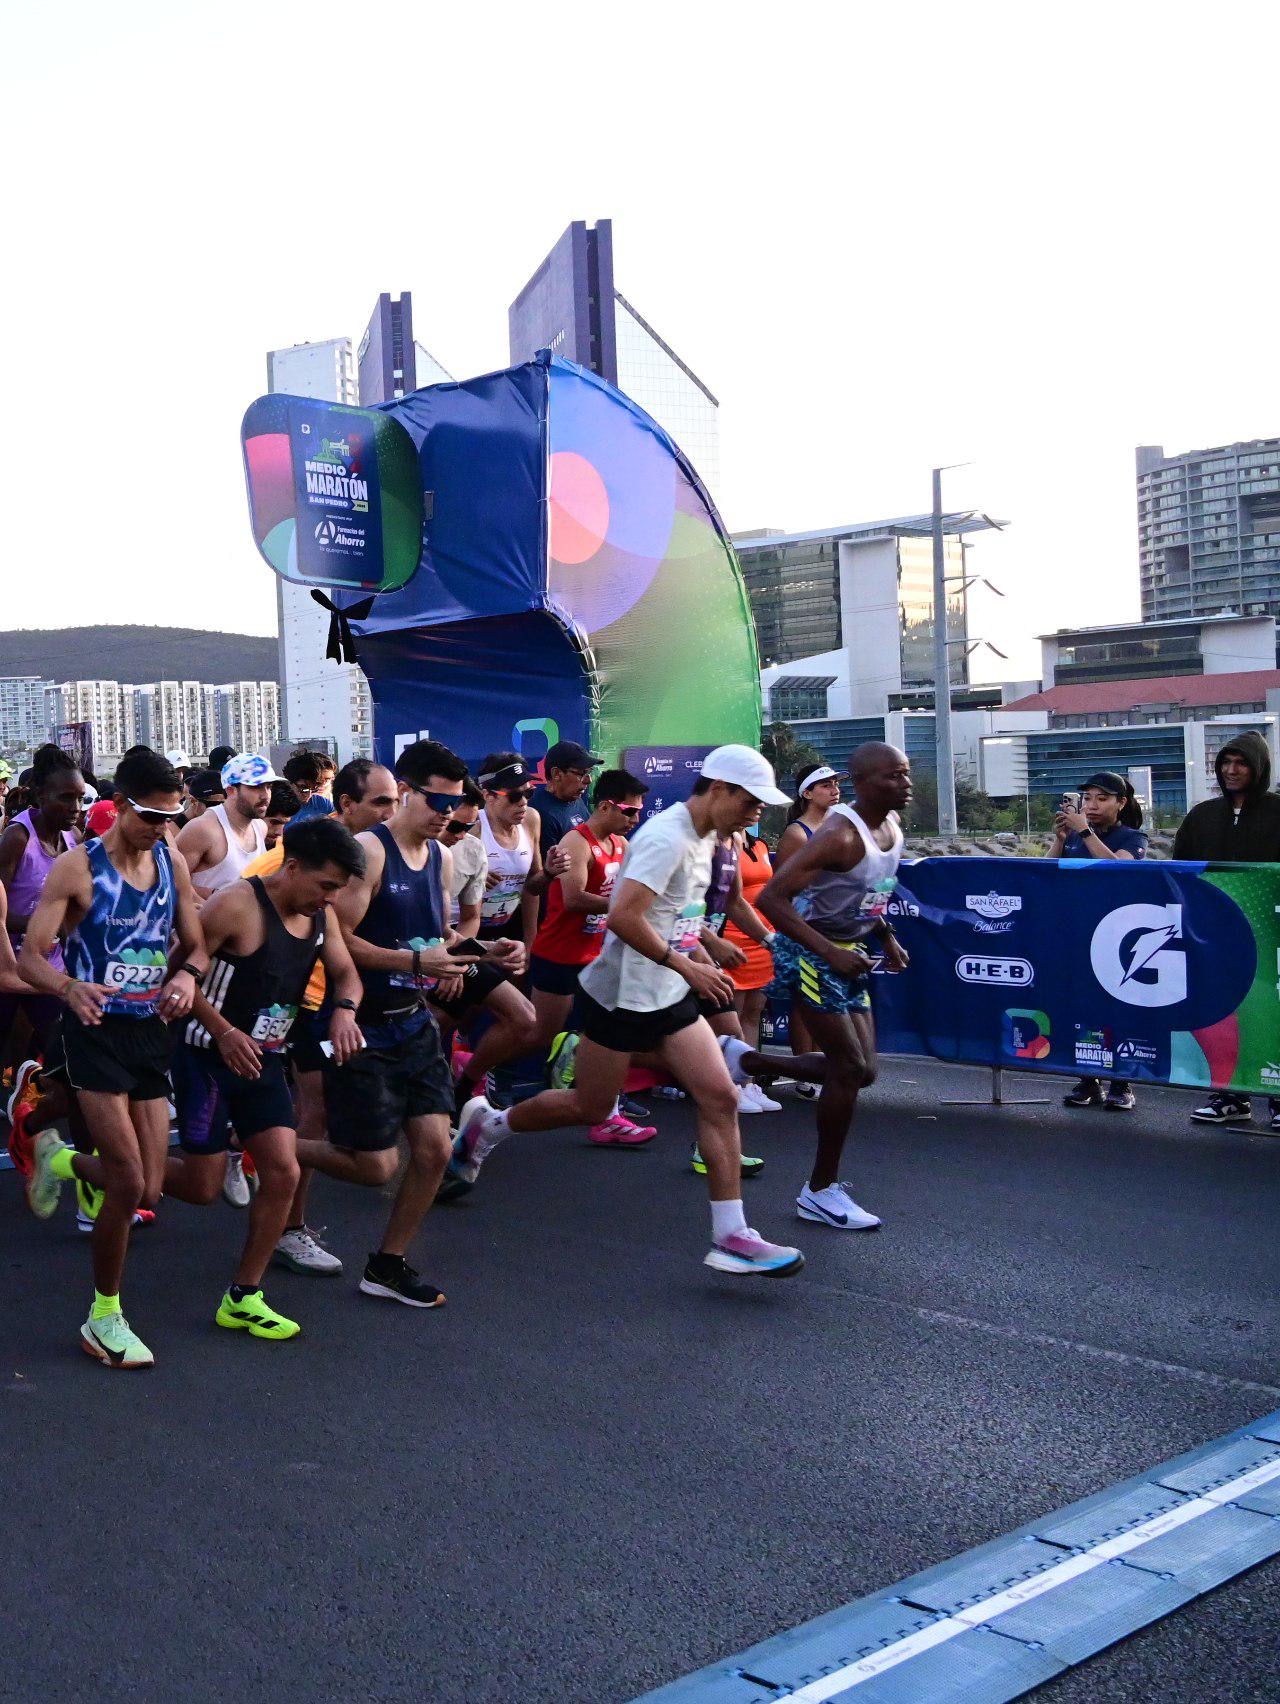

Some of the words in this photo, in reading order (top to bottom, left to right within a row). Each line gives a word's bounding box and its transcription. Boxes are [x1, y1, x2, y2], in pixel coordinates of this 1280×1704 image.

[305, 461, 346, 476] MEDIO
[306, 473, 368, 500] MARATÓN
[310, 496, 324, 504] SAN
[325, 498, 348, 507] PEDRO
[335, 534, 365, 546] Ahorro
[989, 899, 1018, 908] RAFAEL
[973, 920, 1012, 933] Balance
[1090, 903, 1187, 1007] G
[112, 964, 163, 984] 6222
[965, 962, 1024, 979] H-E-B
[1075, 1042, 1102, 1050] MEDIO
[1075, 1048, 1113, 1062] MARATÓN
[1133, 1050, 1156, 1058] Ahorro
